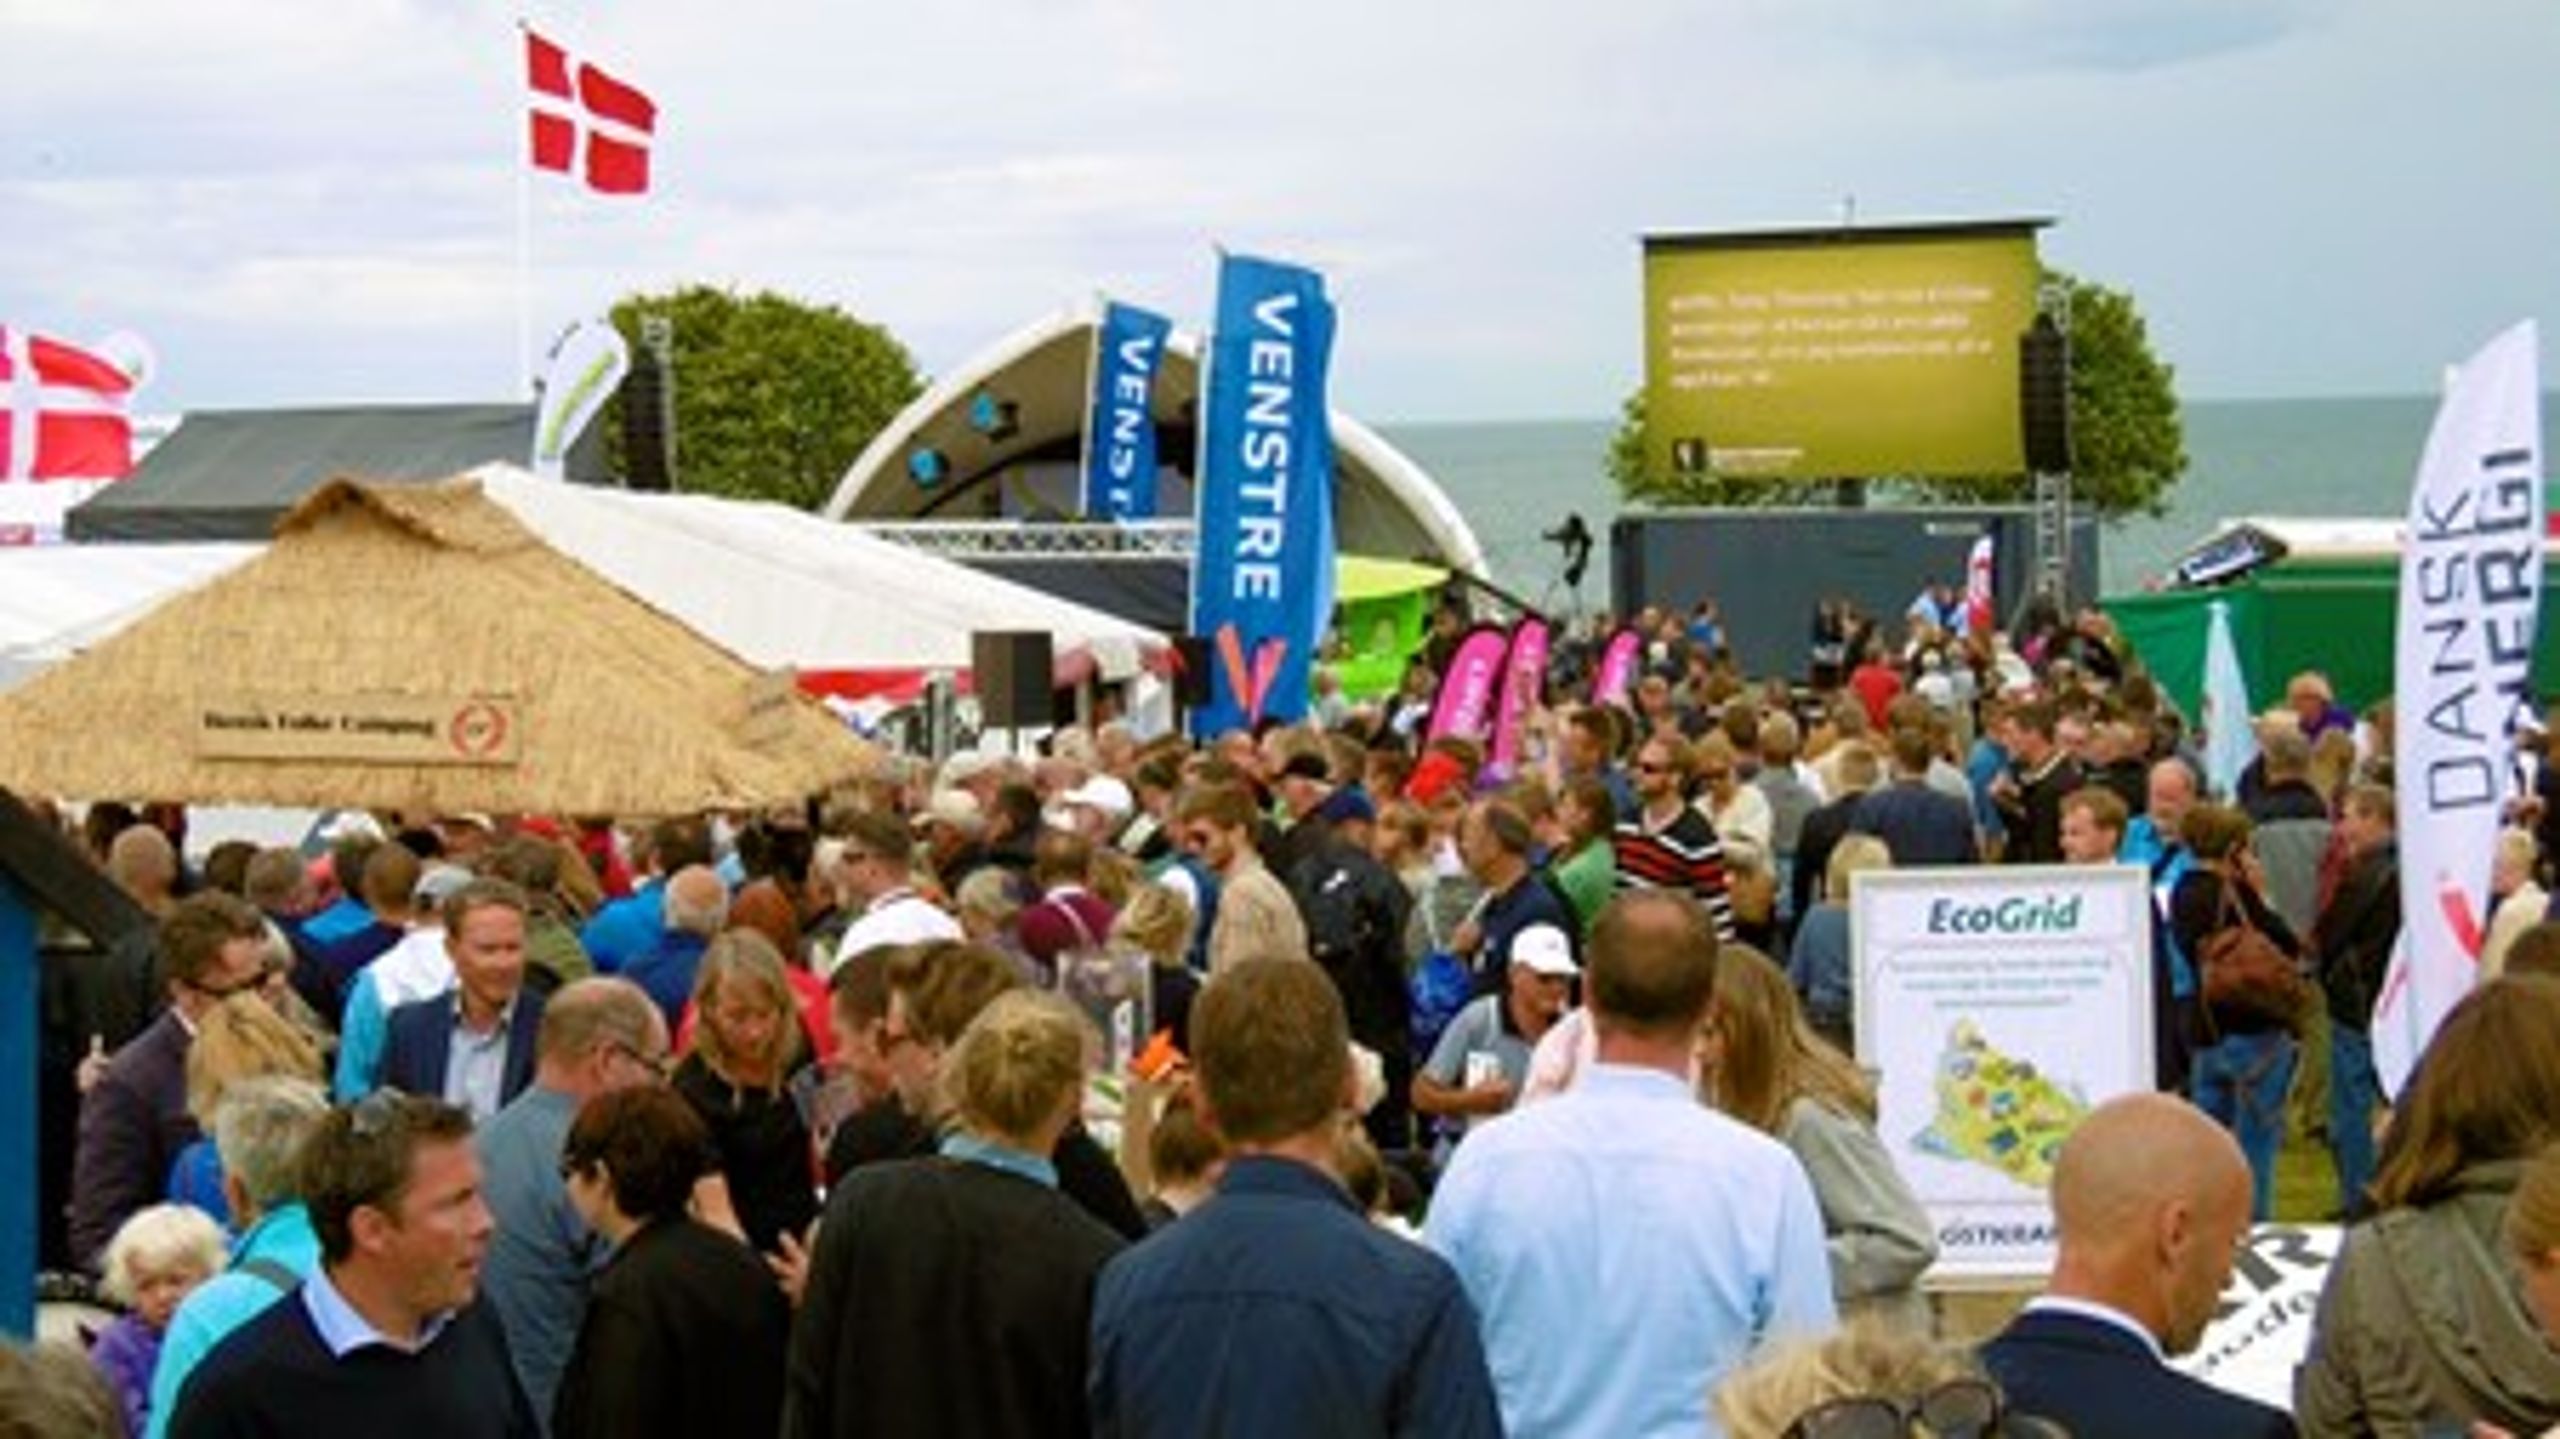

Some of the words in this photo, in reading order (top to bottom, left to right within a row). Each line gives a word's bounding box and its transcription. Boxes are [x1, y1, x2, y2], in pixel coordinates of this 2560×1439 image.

[1233, 294, 1298, 600] VENSTRE
[2417, 489, 2495, 812] DANSK
[1927, 893, 2084, 934] EcoGrid
